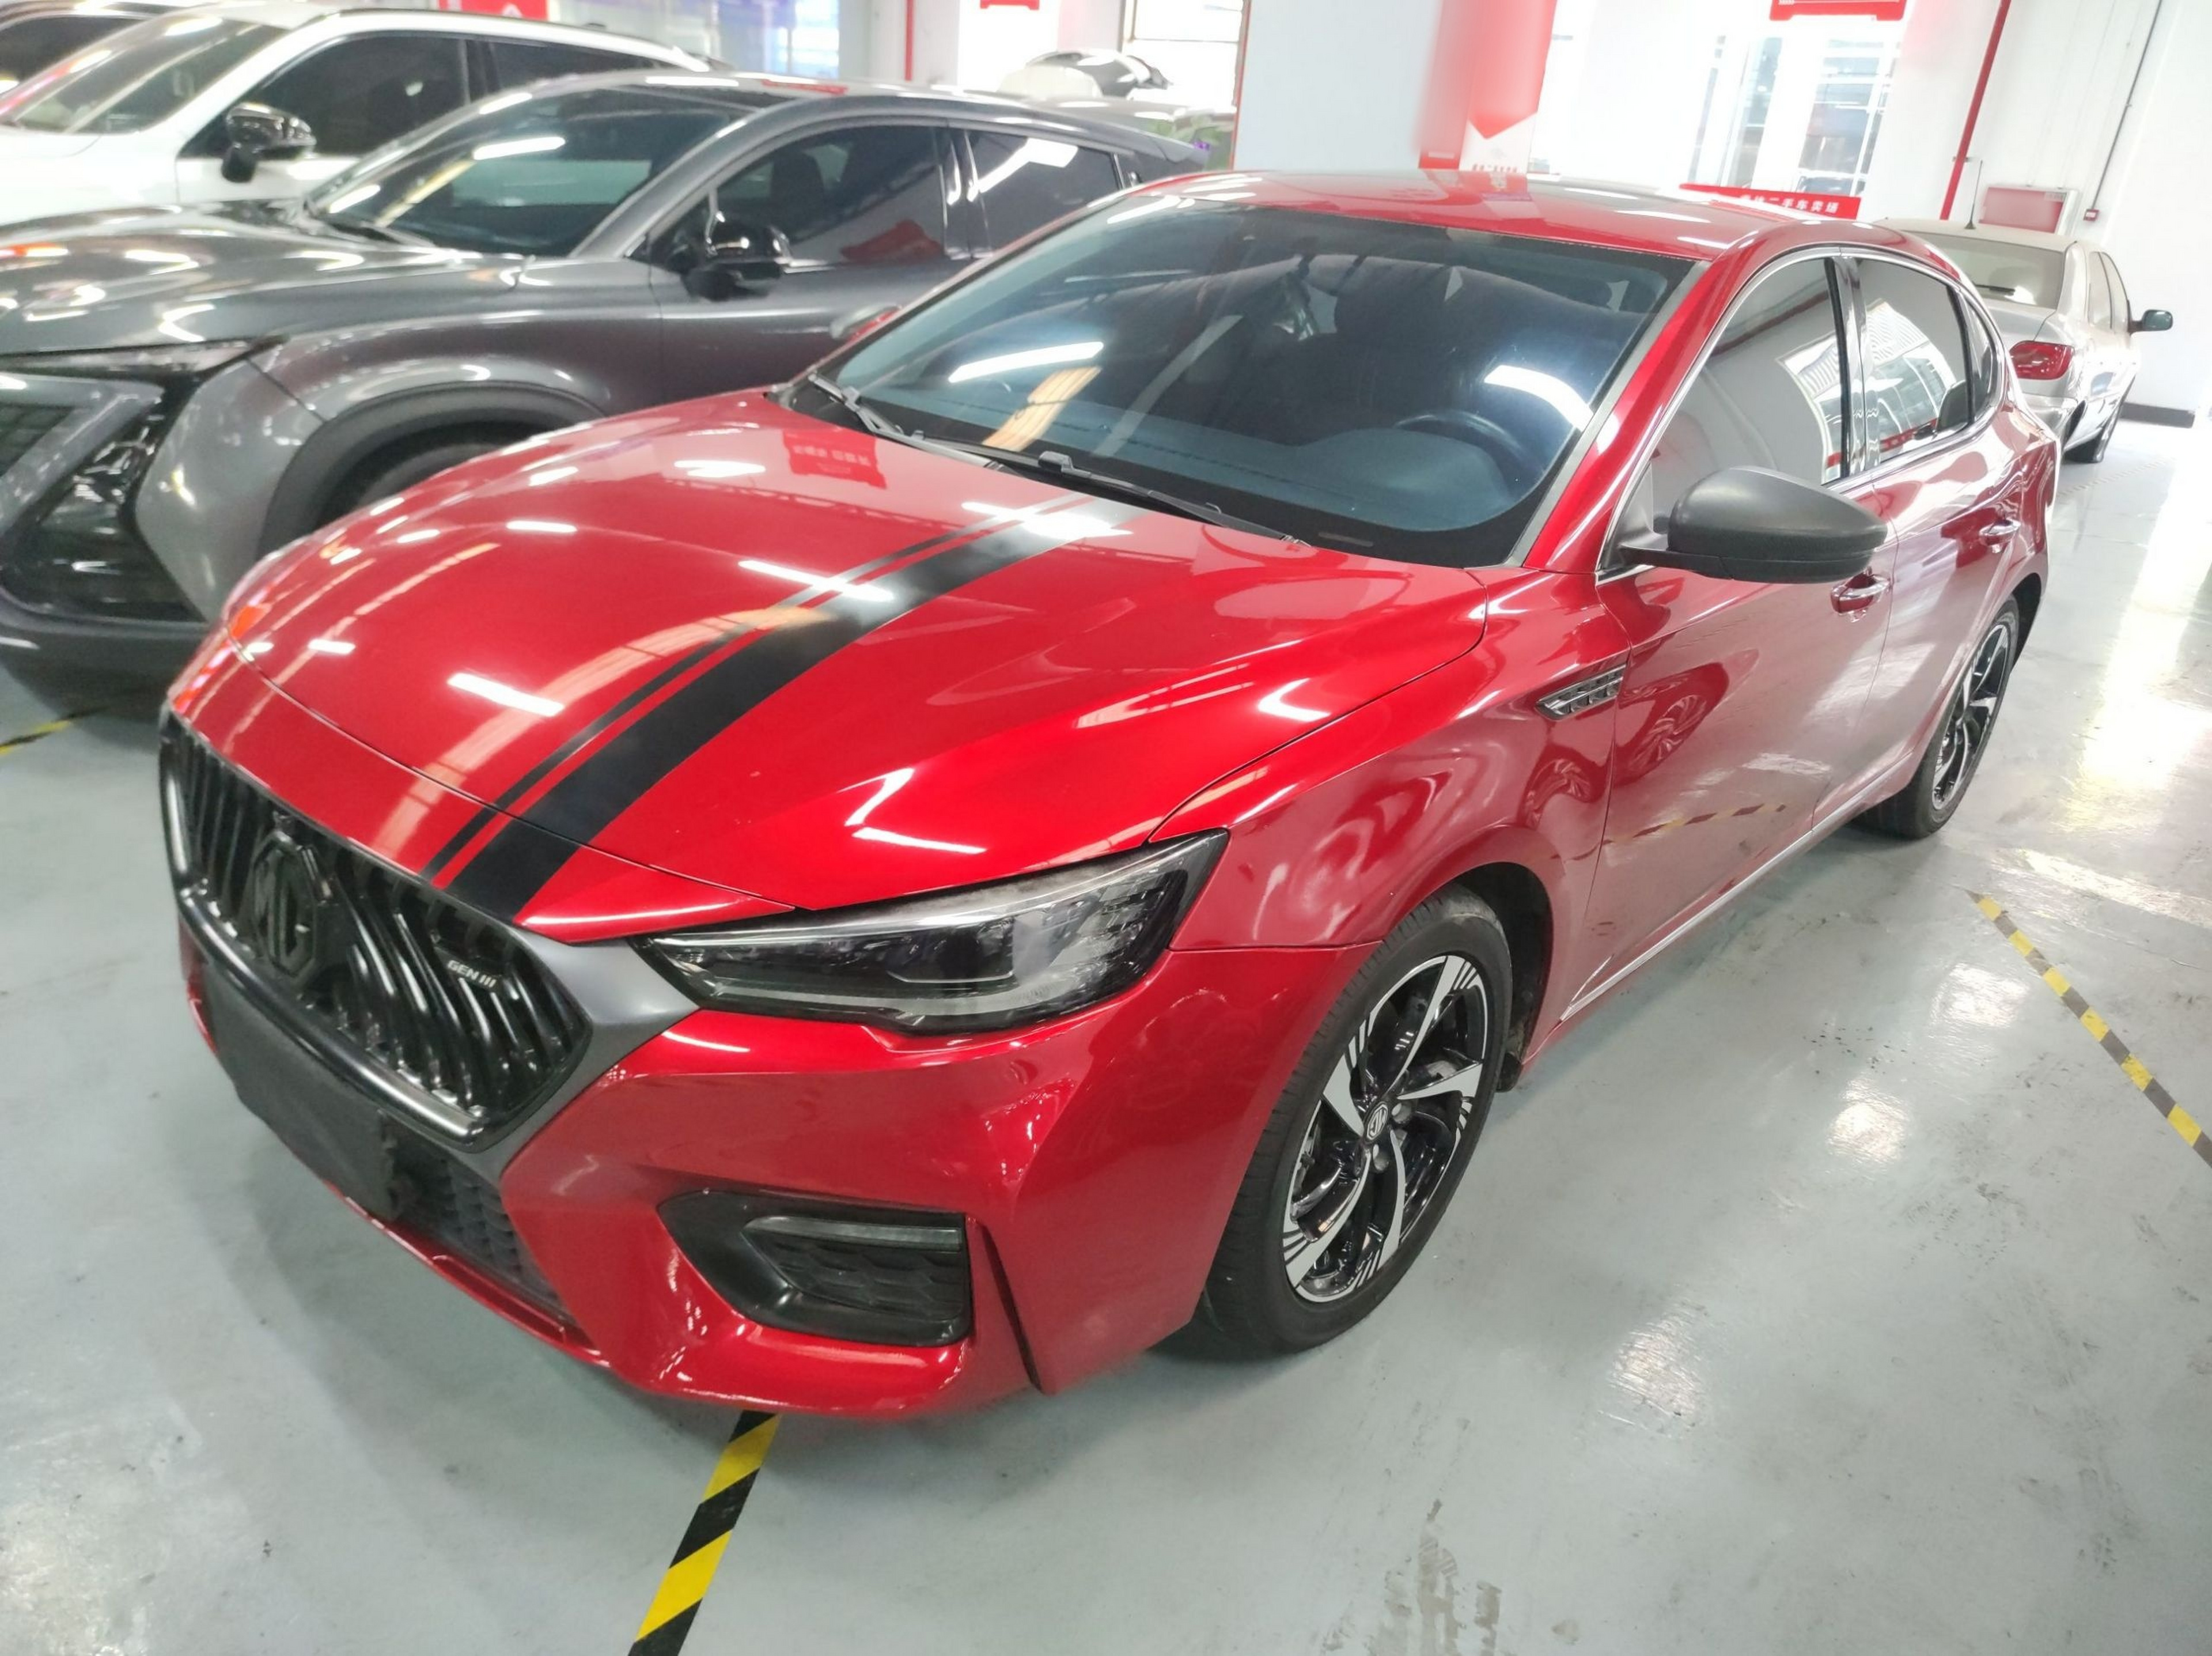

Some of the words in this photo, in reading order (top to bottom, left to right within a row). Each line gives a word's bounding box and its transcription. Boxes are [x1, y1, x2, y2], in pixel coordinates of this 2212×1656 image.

[448, 960, 479, 980] GEN
[479, 974, 497, 988] III
[1369, 1106, 1387, 1138] MG
